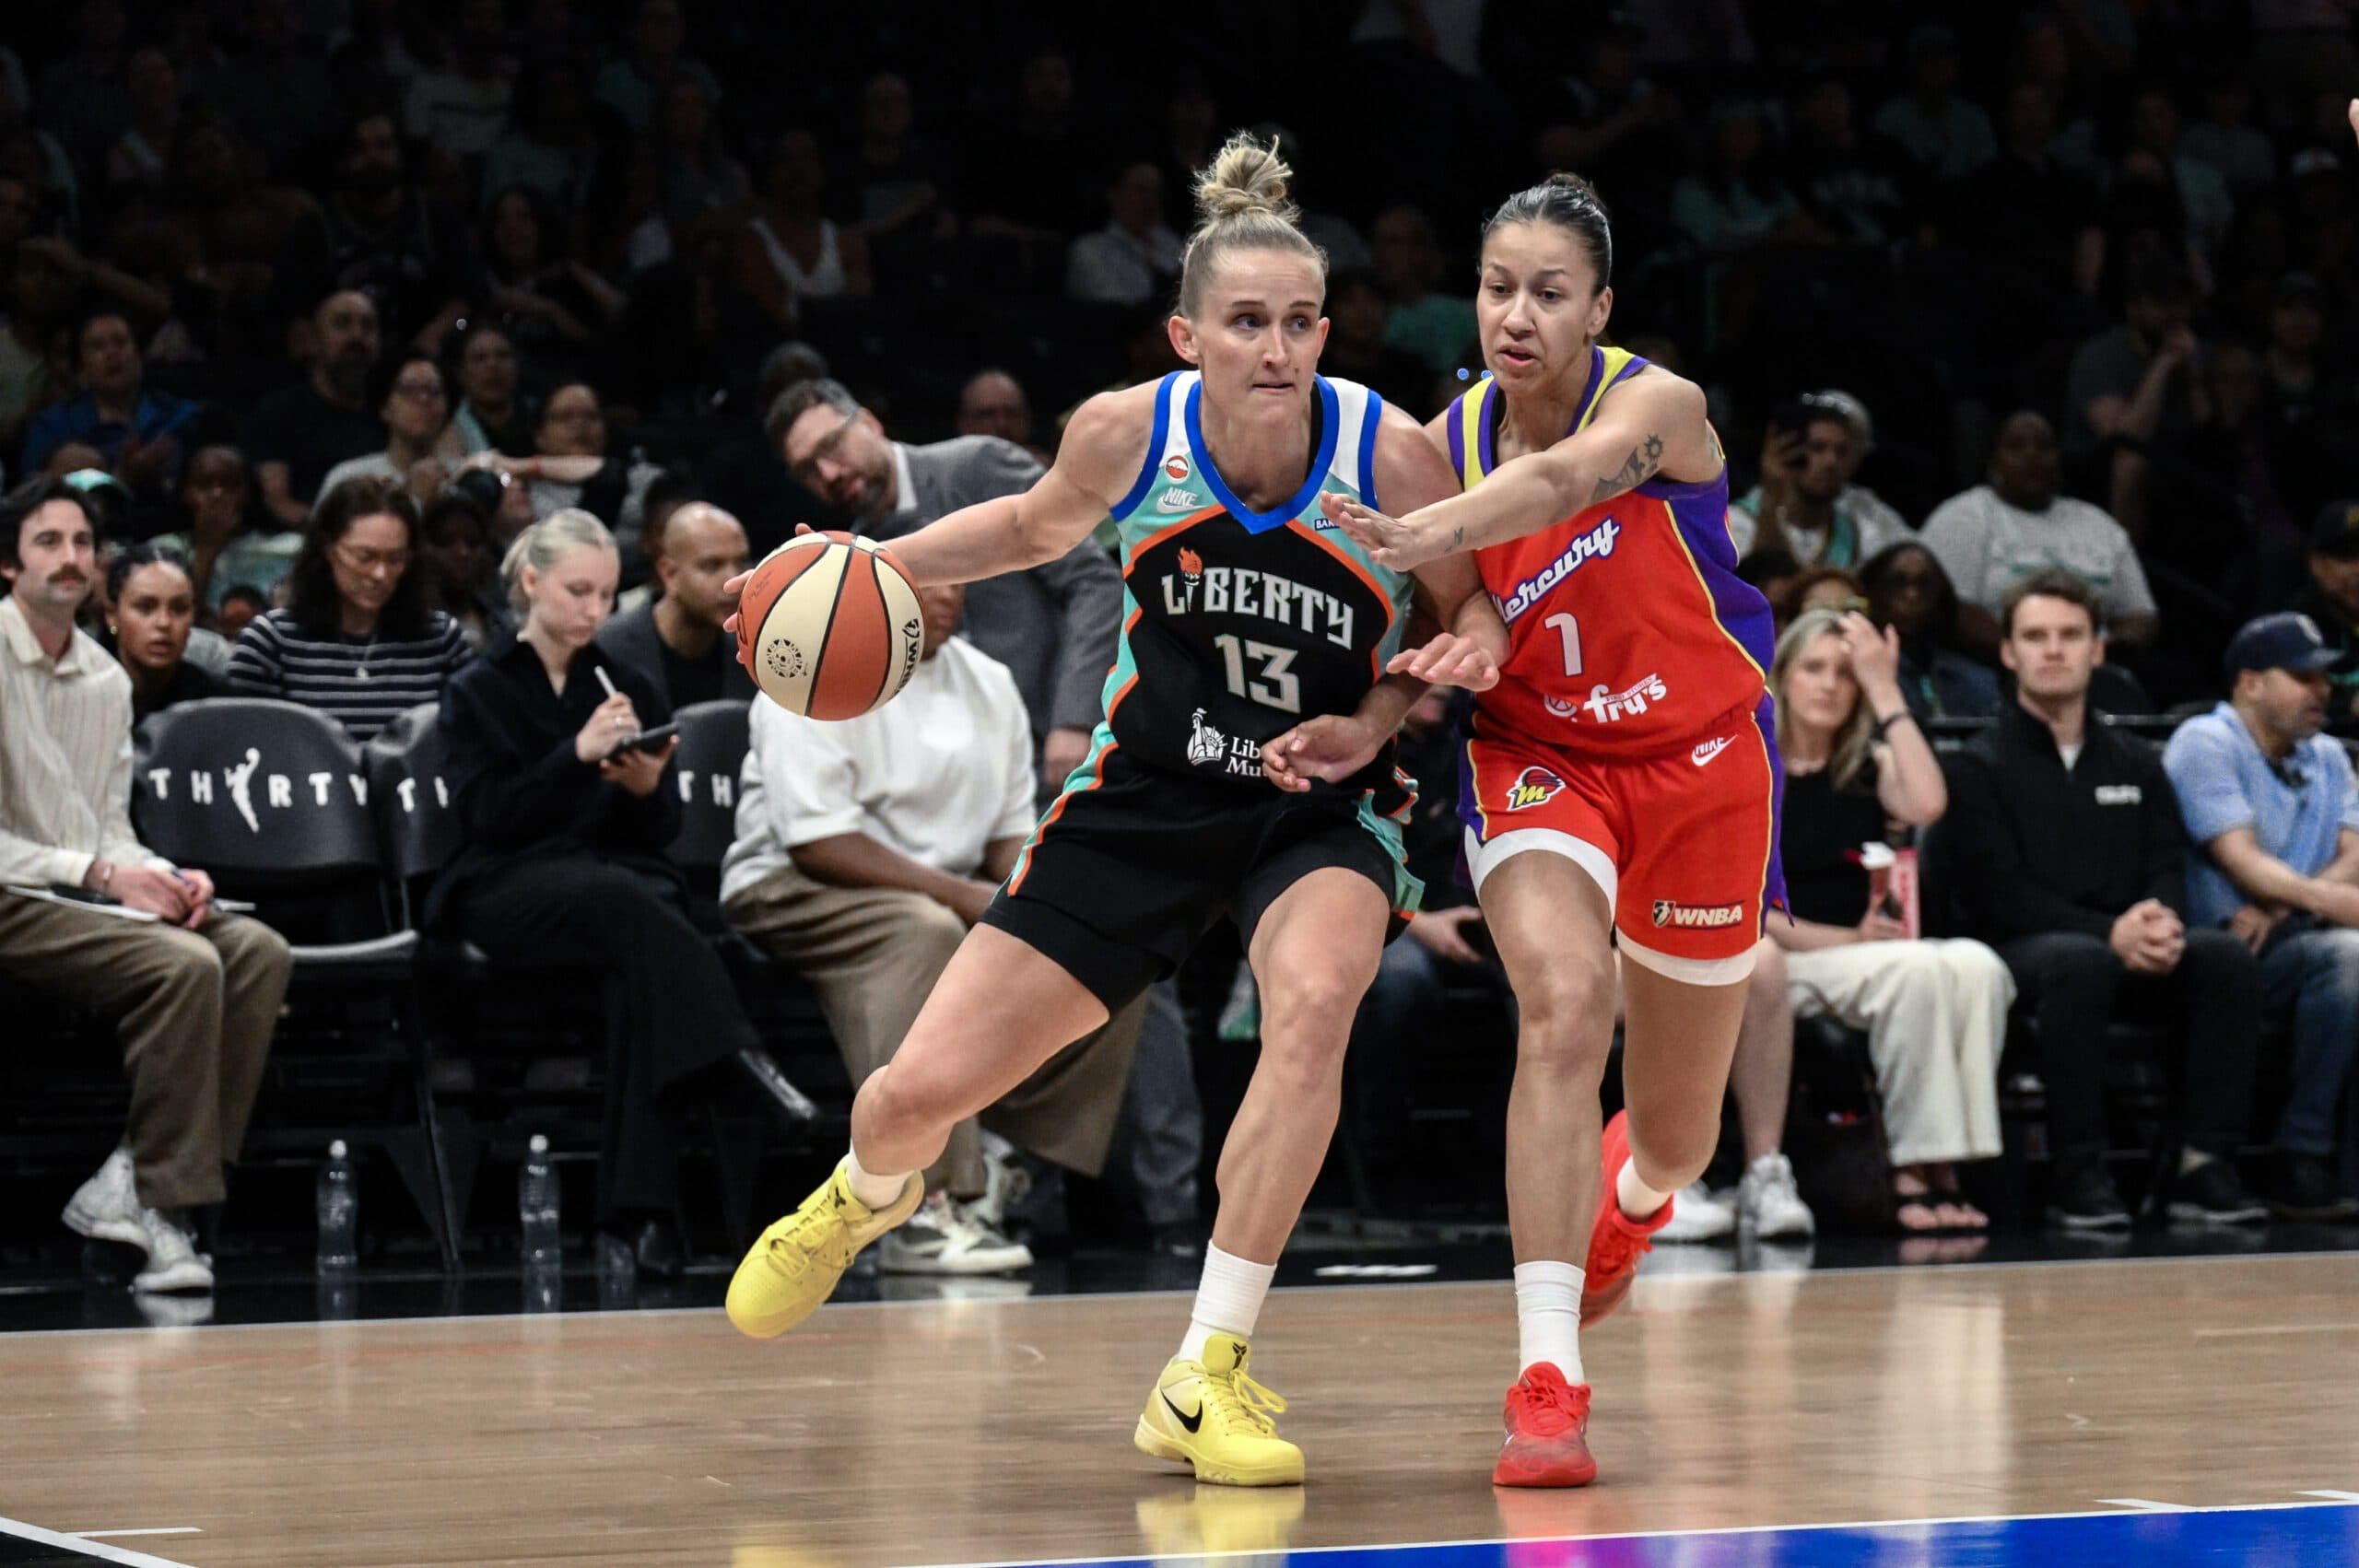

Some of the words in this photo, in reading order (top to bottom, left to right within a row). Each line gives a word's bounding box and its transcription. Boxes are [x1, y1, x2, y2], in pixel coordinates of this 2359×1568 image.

[1164, 486, 1198, 507] NIKE
[1161, 565, 1354, 650] LIBERTY
[1544, 612, 1583, 677] 1
[1215, 633, 1301, 715] 13
[1696, 736, 1724, 755] NIKE
[1225, 756, 1268, 777] Mu
[1674, 905, 1743, 926] WNBA
